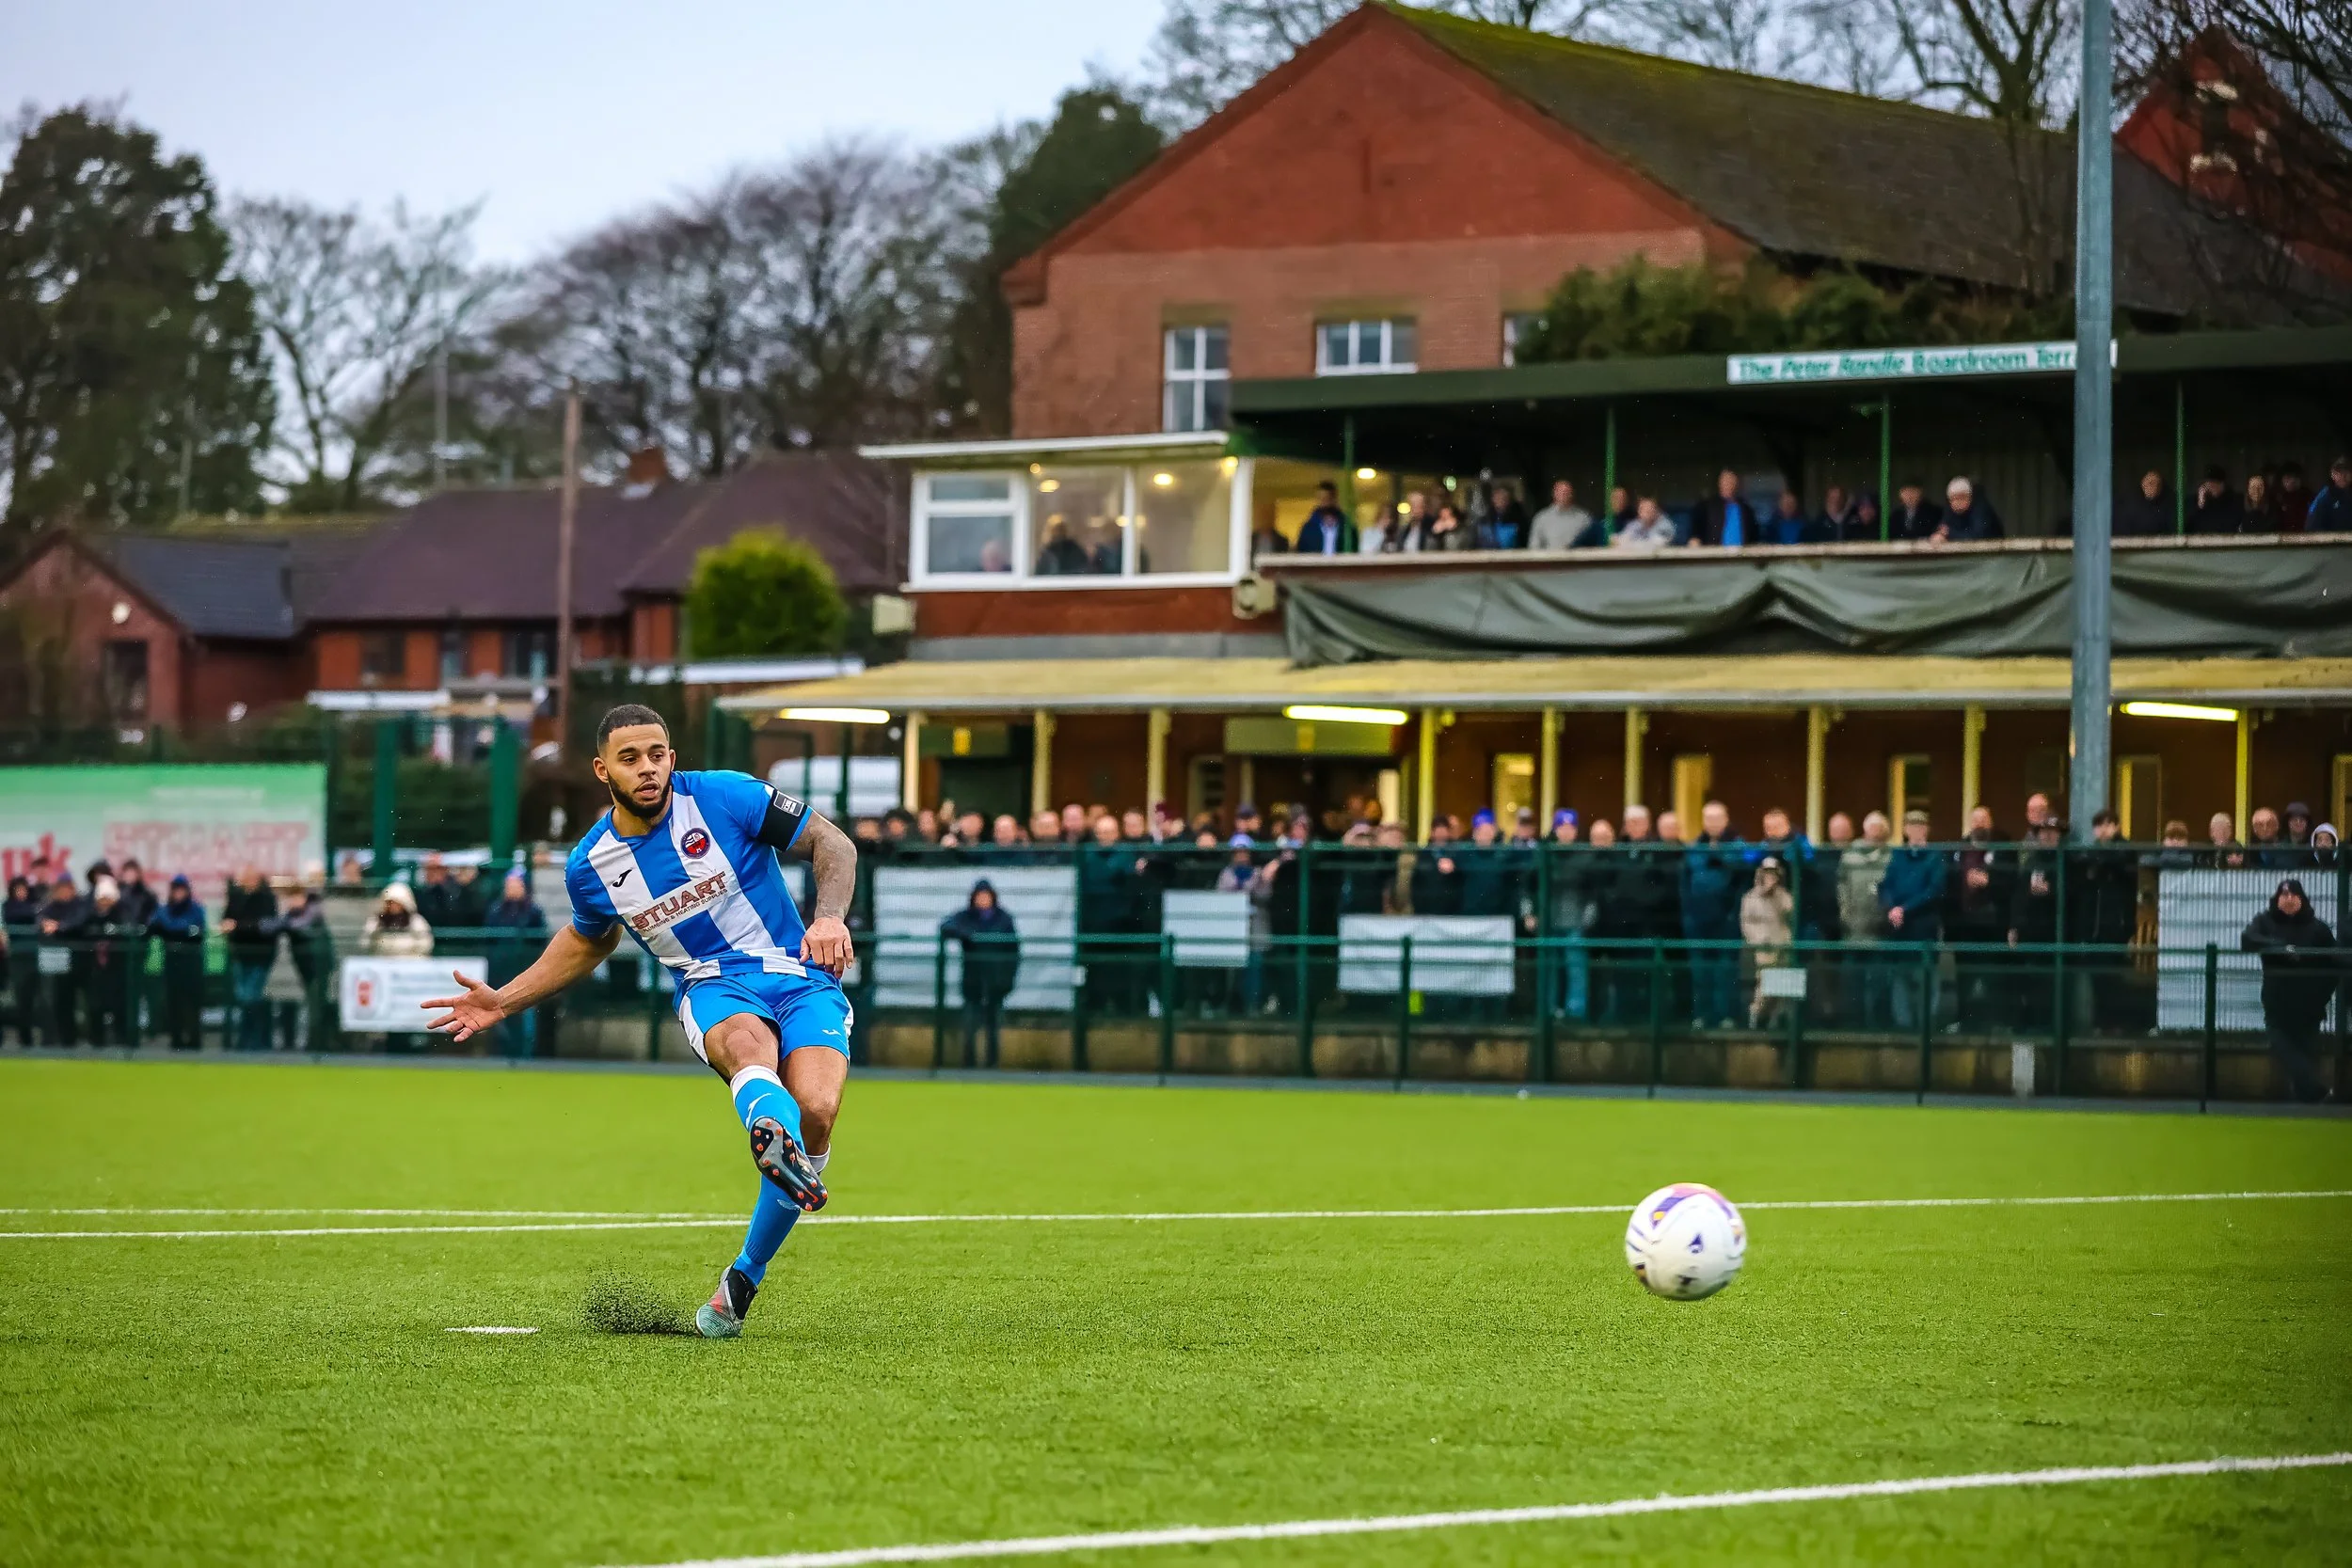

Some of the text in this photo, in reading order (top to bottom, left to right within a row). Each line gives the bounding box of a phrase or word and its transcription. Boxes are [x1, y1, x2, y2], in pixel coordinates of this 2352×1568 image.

[2035, 344, 2077, 369] Terr
[631, 871, 726, 930] STUART
[642, 918, 670, 933] PLUMBING
[675, 902, 701, 916] HEATING
[700, 889, 728, 904] SUPPLIES
